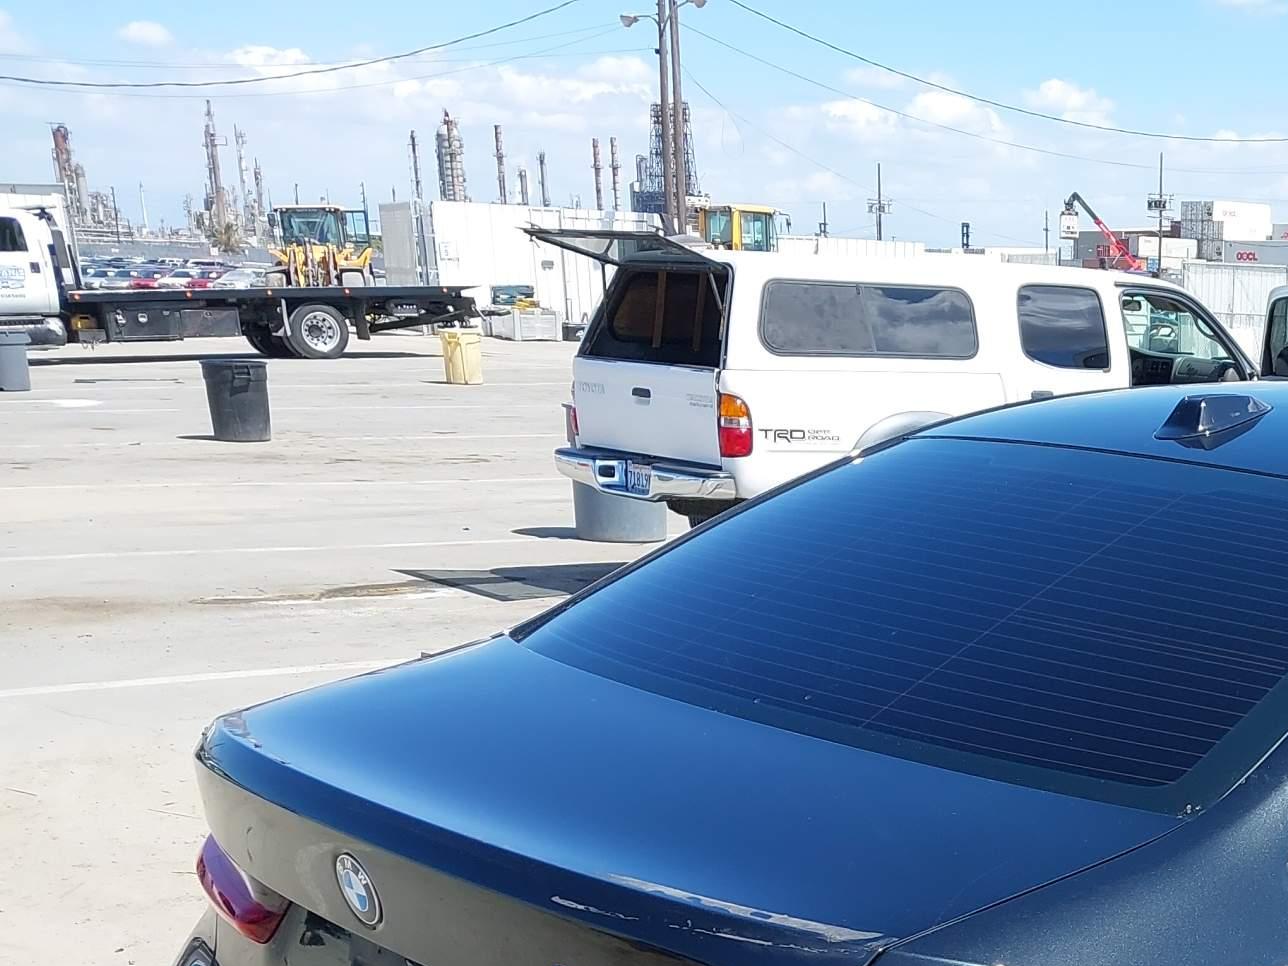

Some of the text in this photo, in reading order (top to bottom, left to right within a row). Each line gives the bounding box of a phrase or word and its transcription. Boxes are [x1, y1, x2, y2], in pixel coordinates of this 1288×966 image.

[1236, 251, 1259, 261] OOCL
[577, 382, 606, 394] TOYOTA
[758, 429, 805, 443] TRD
